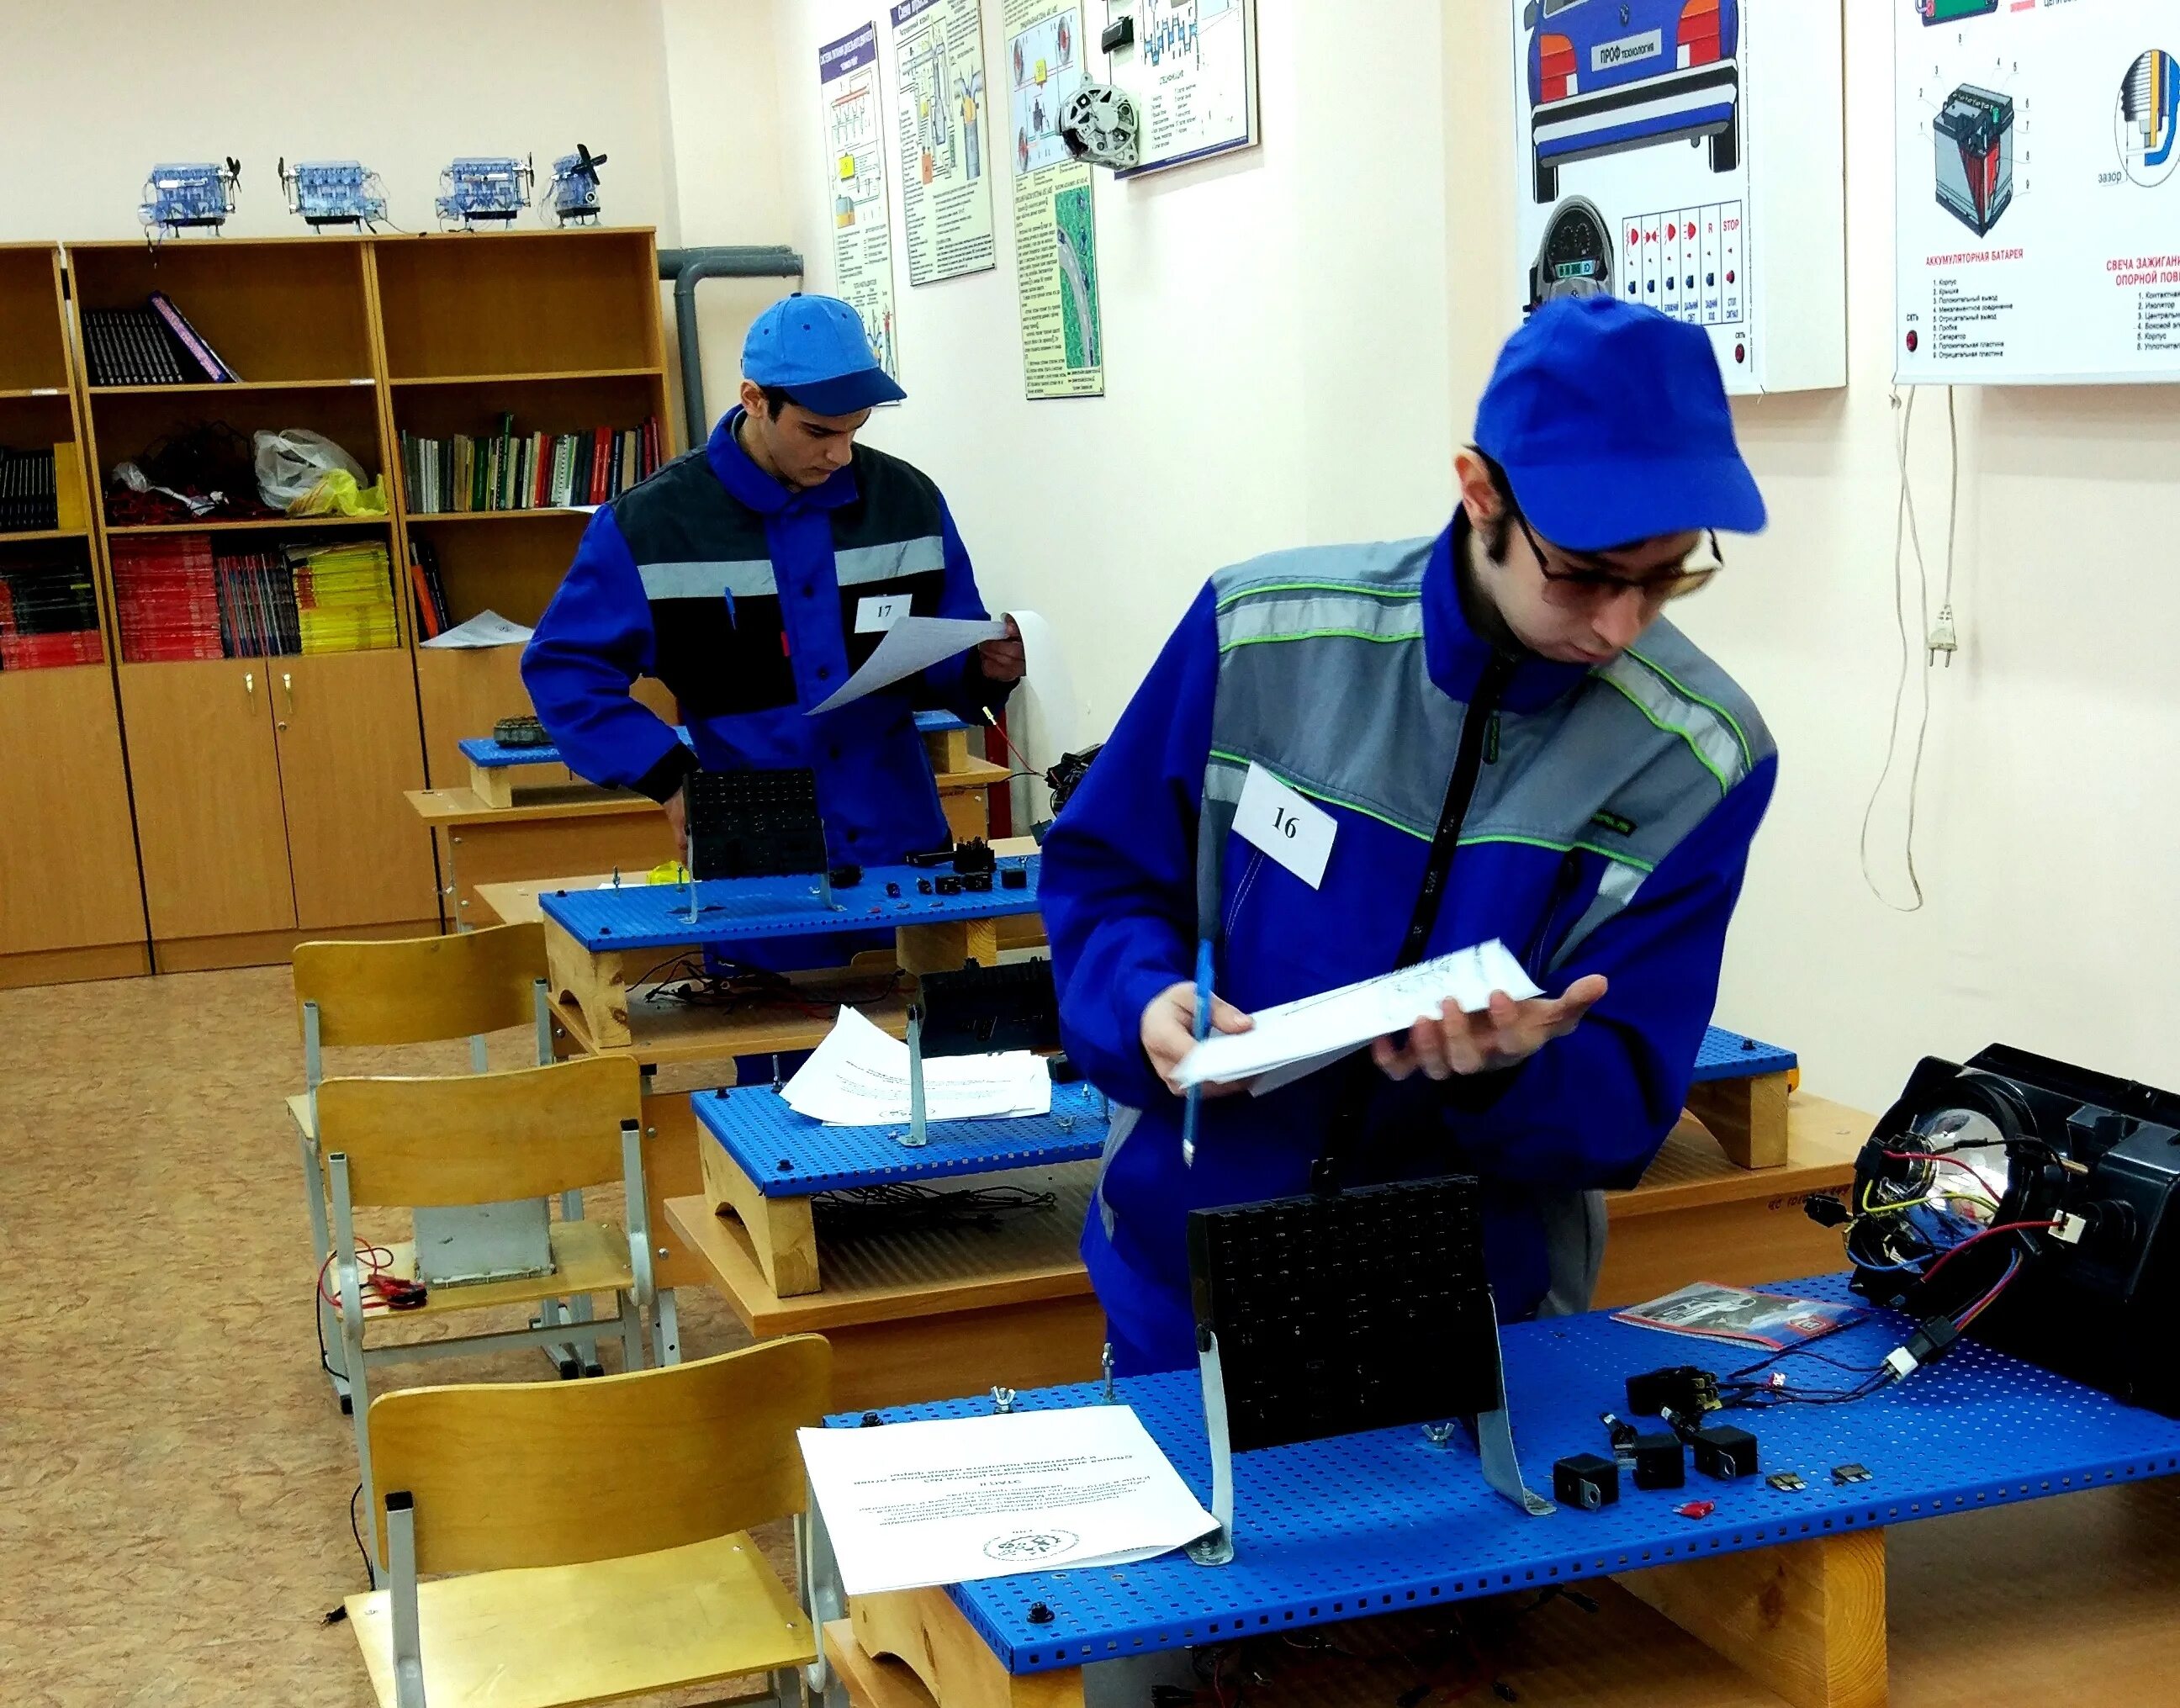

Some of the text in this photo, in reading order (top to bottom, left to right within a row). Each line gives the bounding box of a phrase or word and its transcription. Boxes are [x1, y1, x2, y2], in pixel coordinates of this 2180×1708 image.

[1600, 45, 1621, 64] ПРОФ
[2098, 172, 2122, 184] зазор
[1723, 219, 1739, 232] STOP
[1926, 249, 2024, 266] АККУМУЛЯТОРНАЯ БАТАРЕЯ
[2106, 259, 2134, 271] СВЕЧА
[2116, 271, 2157, 286] ОПОРНОЙ
[876, 605, 892, 618] 17
[1274, 805, 1298, 840] 16
